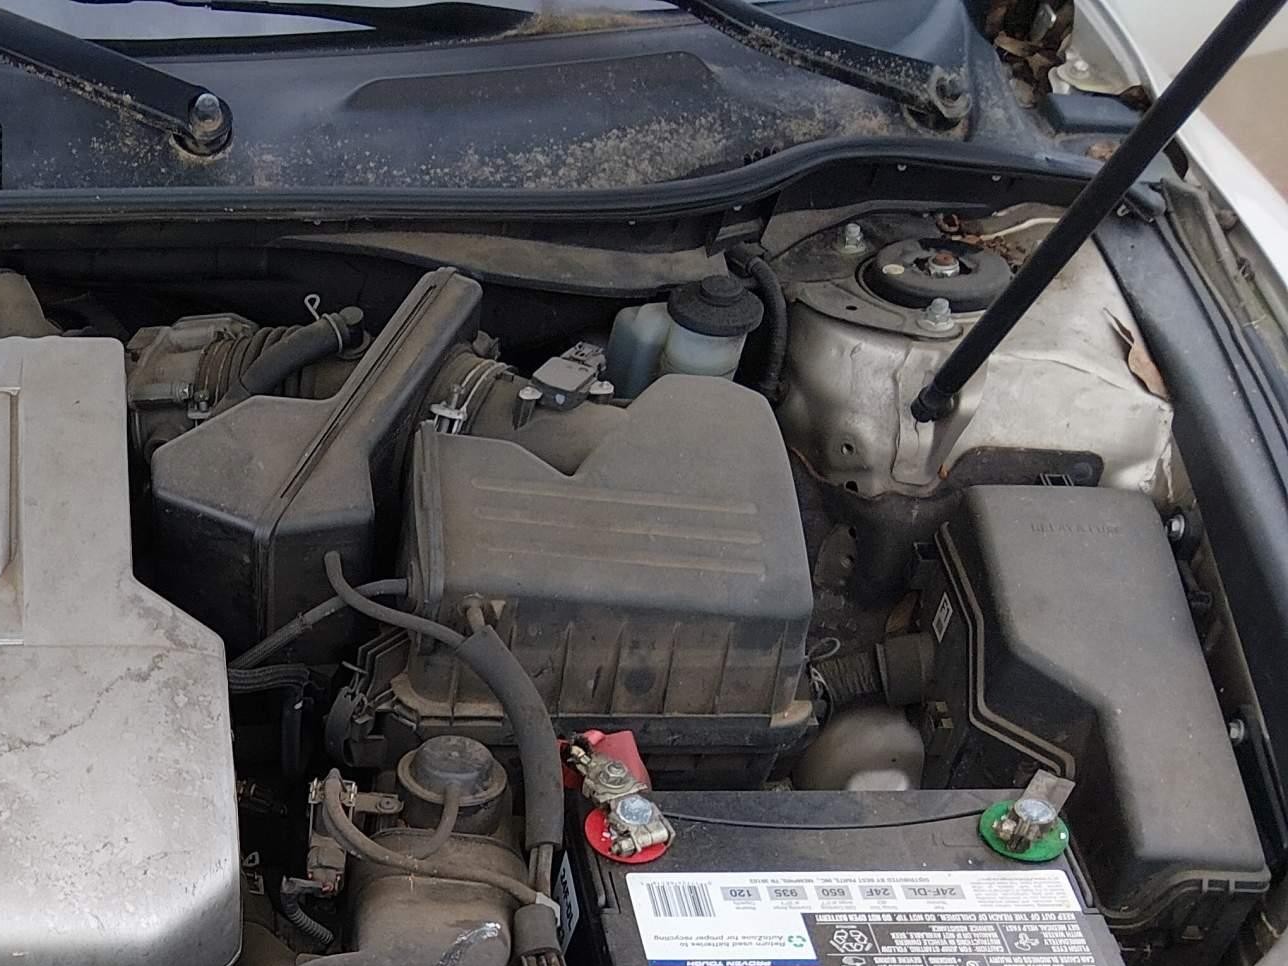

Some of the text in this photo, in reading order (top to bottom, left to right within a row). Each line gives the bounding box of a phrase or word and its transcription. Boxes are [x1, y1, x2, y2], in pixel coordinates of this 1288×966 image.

[729, 889, 753, 898] 120
[774, 888, 799, 897] 935
[820, 888, 846, 897] 650
[866, 887, 891, 897] 24F
[907, 887, 956, 897] 24F-DL
[909, 913, 925, 921] NOT
[977, 913, 988, 921] OF
[987, 913, 1014, 921] REACH
[1013, 913, 1029, 921] THE
[1031, 913, 1042, 921] OF
[1041, 913, 1057, 921] OUT
[1057, 913, 1076, 921] KEEP
